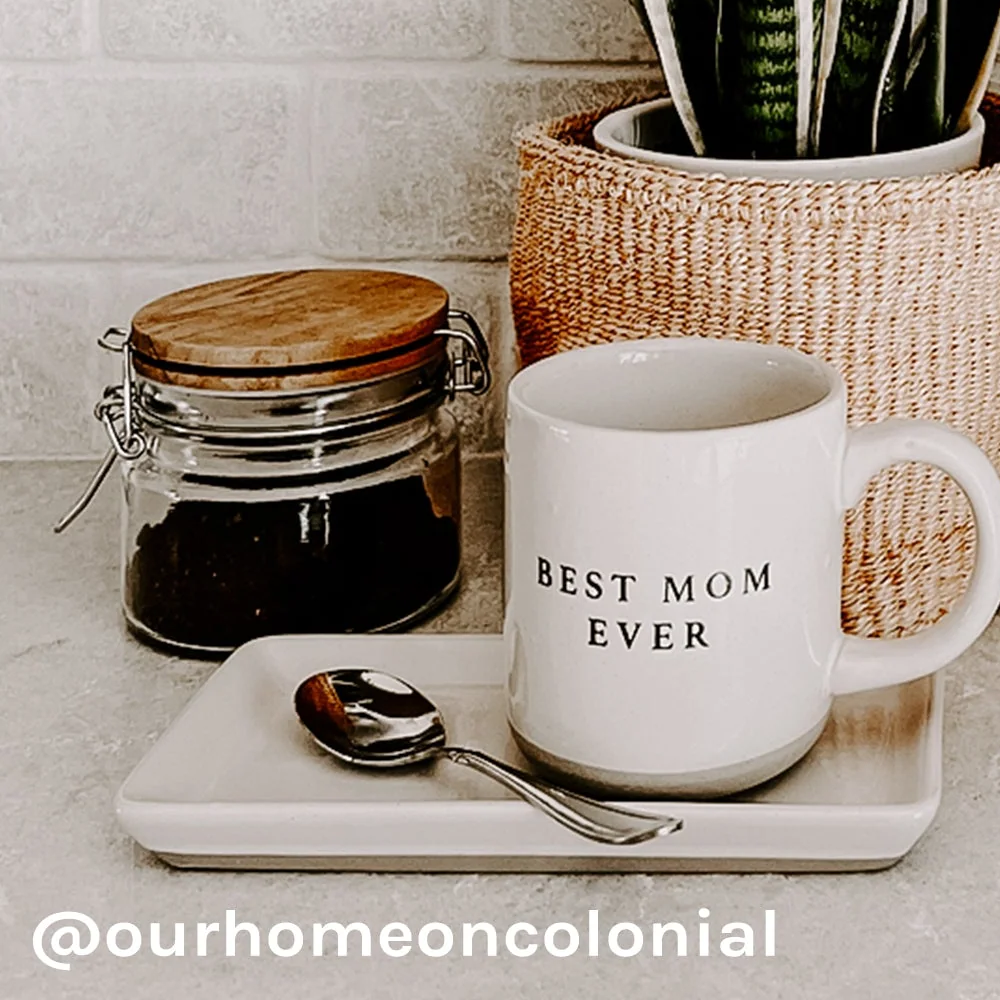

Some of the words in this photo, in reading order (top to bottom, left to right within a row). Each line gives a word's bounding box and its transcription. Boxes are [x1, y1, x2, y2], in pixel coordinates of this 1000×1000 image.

[537, 556, 636, 602] BEST
[662, 562, 771, 603] MOM
[588, 617, 708, 650] EVER
